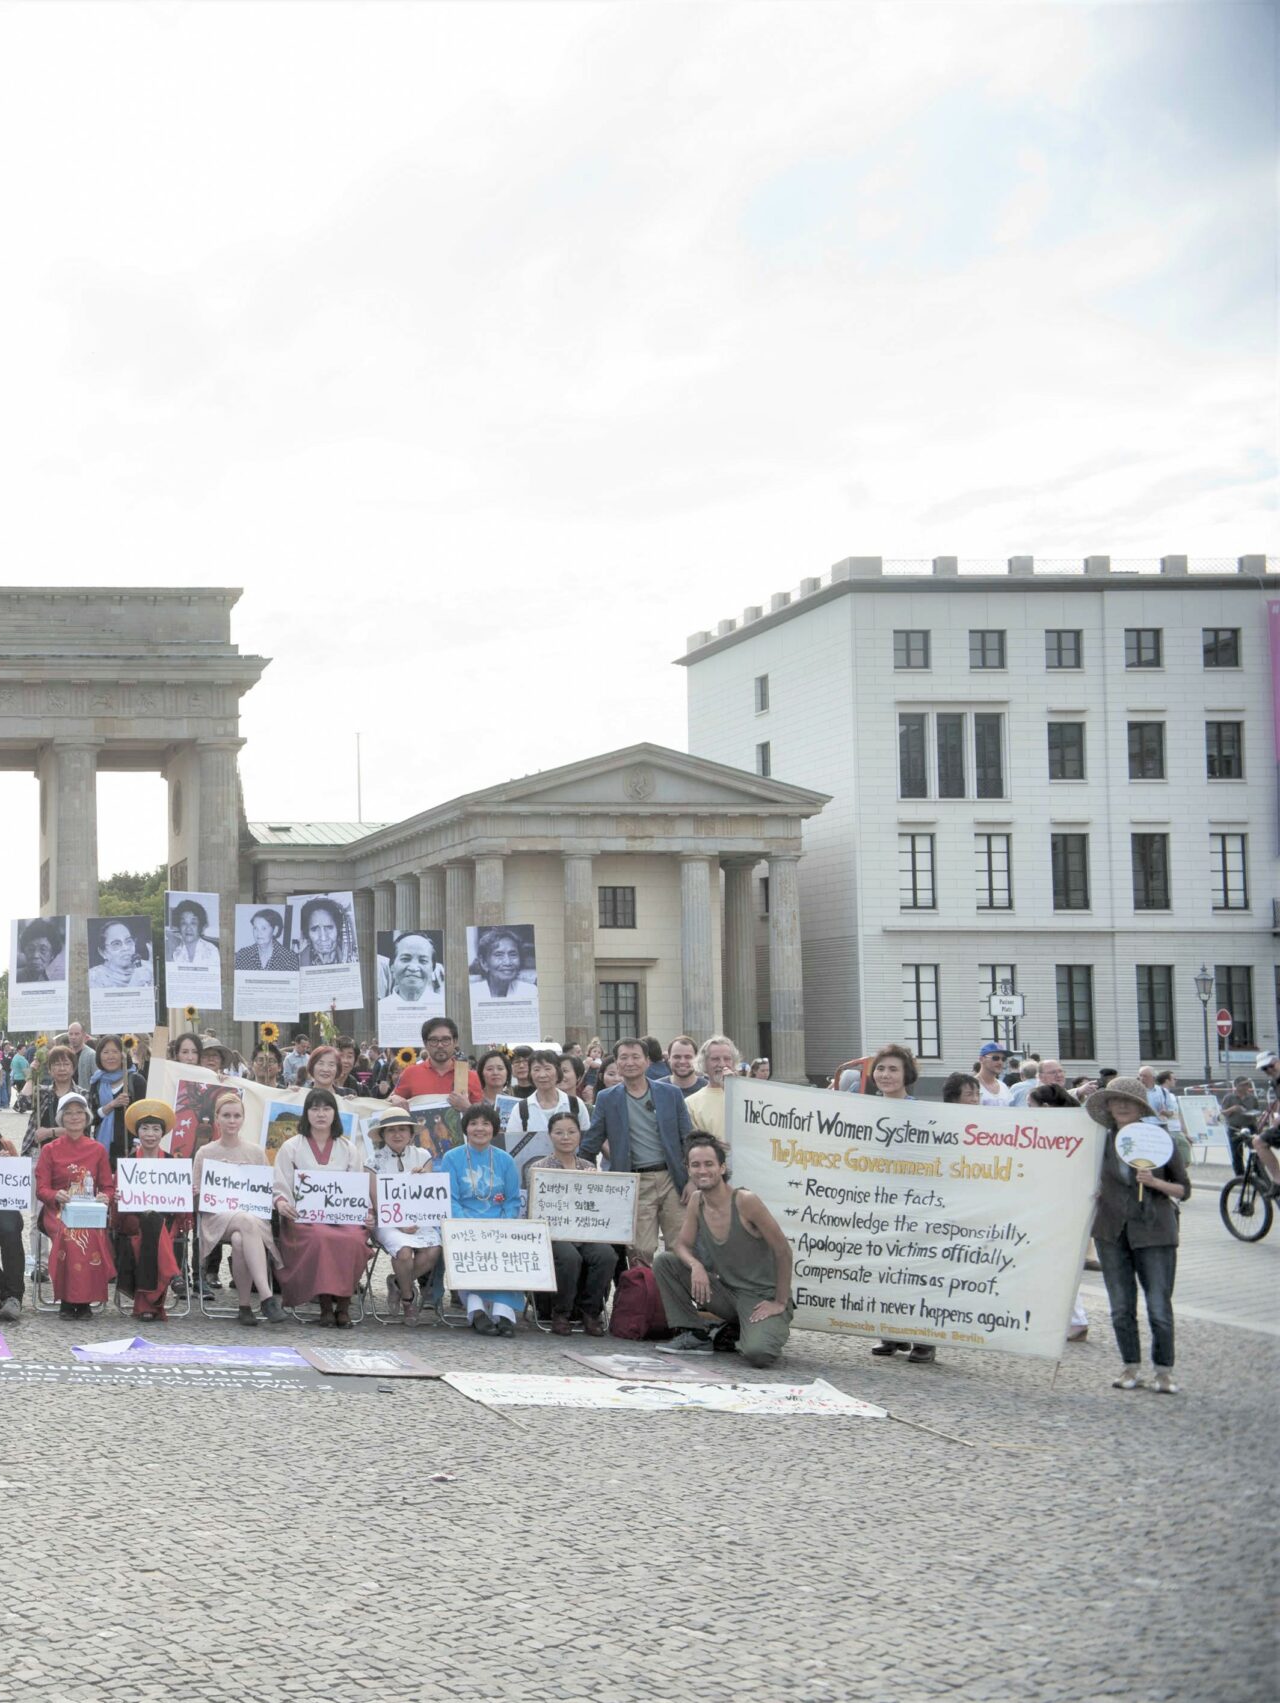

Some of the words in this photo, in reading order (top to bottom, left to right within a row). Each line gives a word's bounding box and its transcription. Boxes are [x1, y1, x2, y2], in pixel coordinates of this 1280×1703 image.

[744, 1099, 761, 1124] The
[817, 1110, 873, 1141] Women
[932, 1130, 959, 1145] was
[963, 1124, 1020, 1148] Sexual
[1019, 1126, 1084, 1158] Slavery
[769, 1138, 790, 1163] The
[844, 1146, 943, 1177] Government
[120, 1162, 192, 1187] Vietnam
[204, 1169, 273, 1195] Netherlands
[300, 1175, 343, 1195] South
[120, 1190, 186, 1207] Unknown
[379, 1177, 448, 1201] Taiwan
[805, 1178, 870, 1205] Recognise
[875, 1186, 898, 1204] the
[904, 1189, 946, 1208] facts.
[324, 1194, 368, 1209] Korea
[380, 1203, 403, 1223] 58
[405, 1212, 448, 1223] registered
[298, 1209, 326, 1221] 237
[801, 1205, 889, 1235] Acknowledge
[894, 1214, 918, 1233] the
[451, 1229, 478, 1242] 이것은
[501, 1250, 541, 1273] 원천무효
[798, 1232, 863, 1261] Apologize
[866, 1240, 883, 1257] to
[886, 1239, 937, 1258] victims
[942, 1244, 1016, 1273] officially.
[794, 1259, 872, 1283] Compensate
[878, 1266, 928, 1286] victims
[929, 1276, 945, 1288] as
[948, 1276, 999, 1298] proof.
[796, 1287, 836, 1309] Ensure
[840, 1293, 864, 1312] that
[865, 1295, 877, 1313] it
[879, 1301, 916, 1316] never
[920, 1298, 973, 1328] happens
[68, 1377, 153, 1385] during
[161, 1380, 242, 1388] World
[114, 1366, 273, 1376] violence
